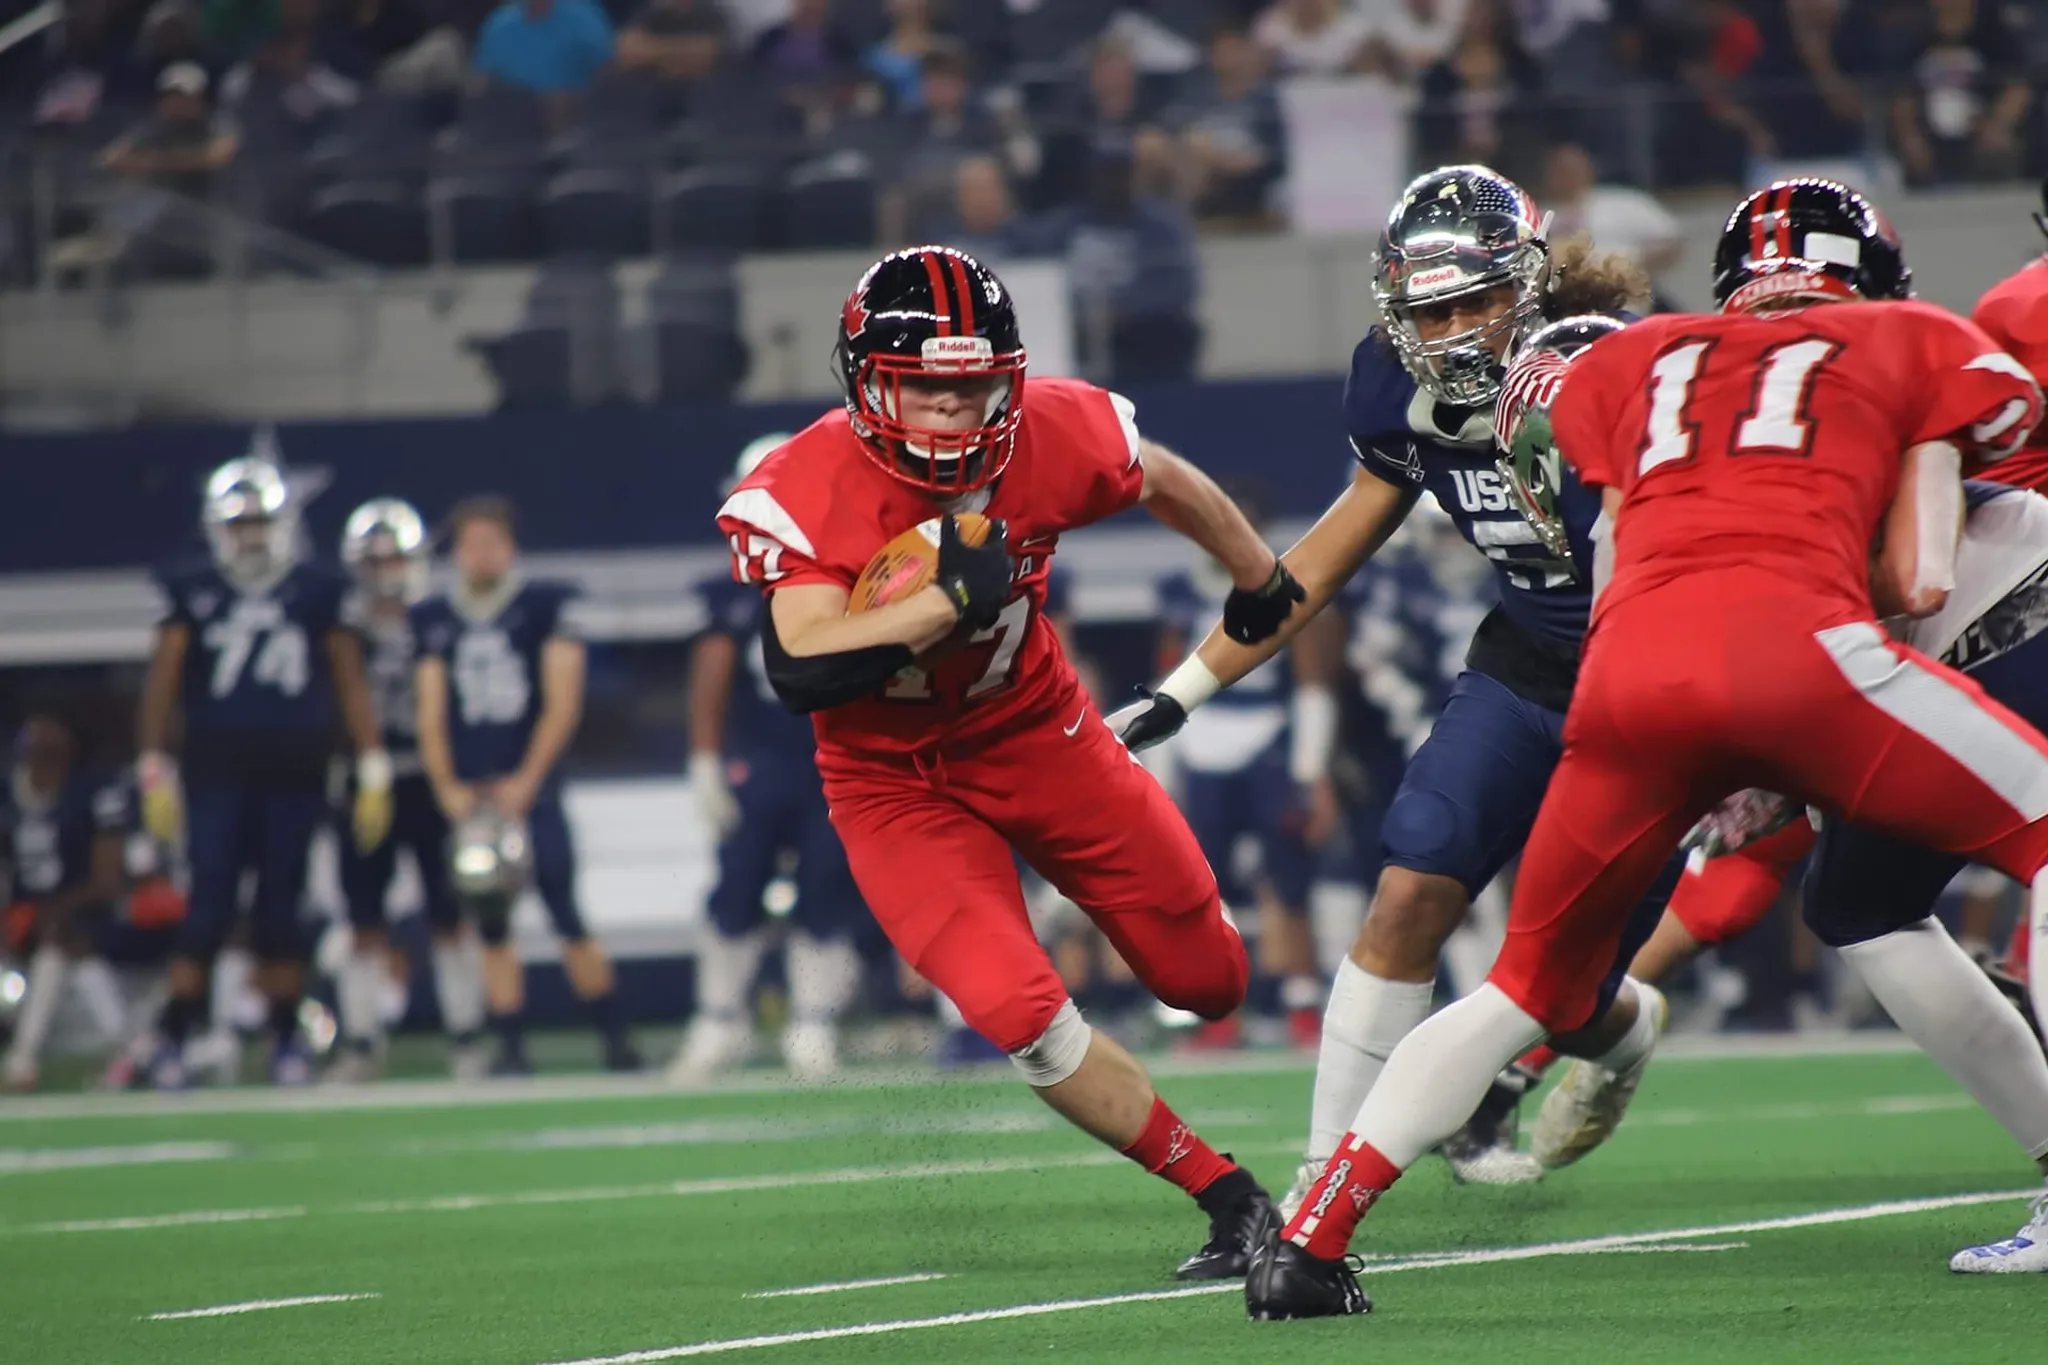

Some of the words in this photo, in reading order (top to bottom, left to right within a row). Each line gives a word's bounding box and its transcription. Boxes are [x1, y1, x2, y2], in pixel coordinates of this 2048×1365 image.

[1412, 269, 1455, 286] Riddell
[938, 341, 976, 352] Riddell
[1638, 340, 1834, 478] 11
[1449, 470, 1518, 512] US
[730, 533, 785, 584] 17
[203, 618, 309, 698] 74
